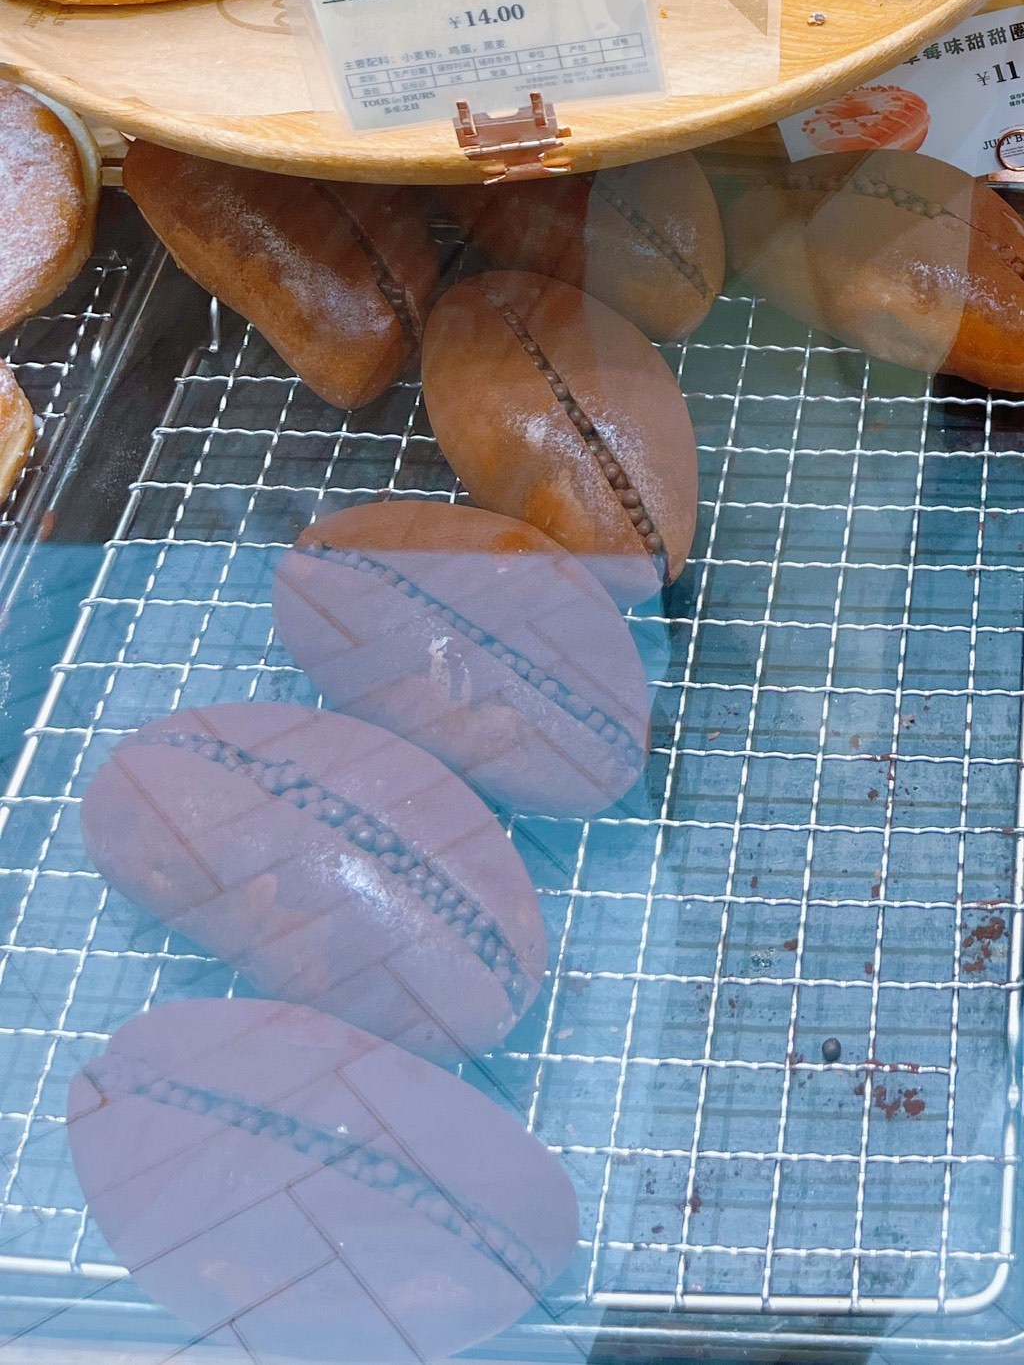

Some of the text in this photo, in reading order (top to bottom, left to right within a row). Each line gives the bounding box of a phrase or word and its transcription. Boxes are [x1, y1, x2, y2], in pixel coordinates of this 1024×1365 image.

[448, 3, 526, 30] ¥14.00
[361, 97, 391, 109] TOUS
[402, 91, 437, 105] JOURS
